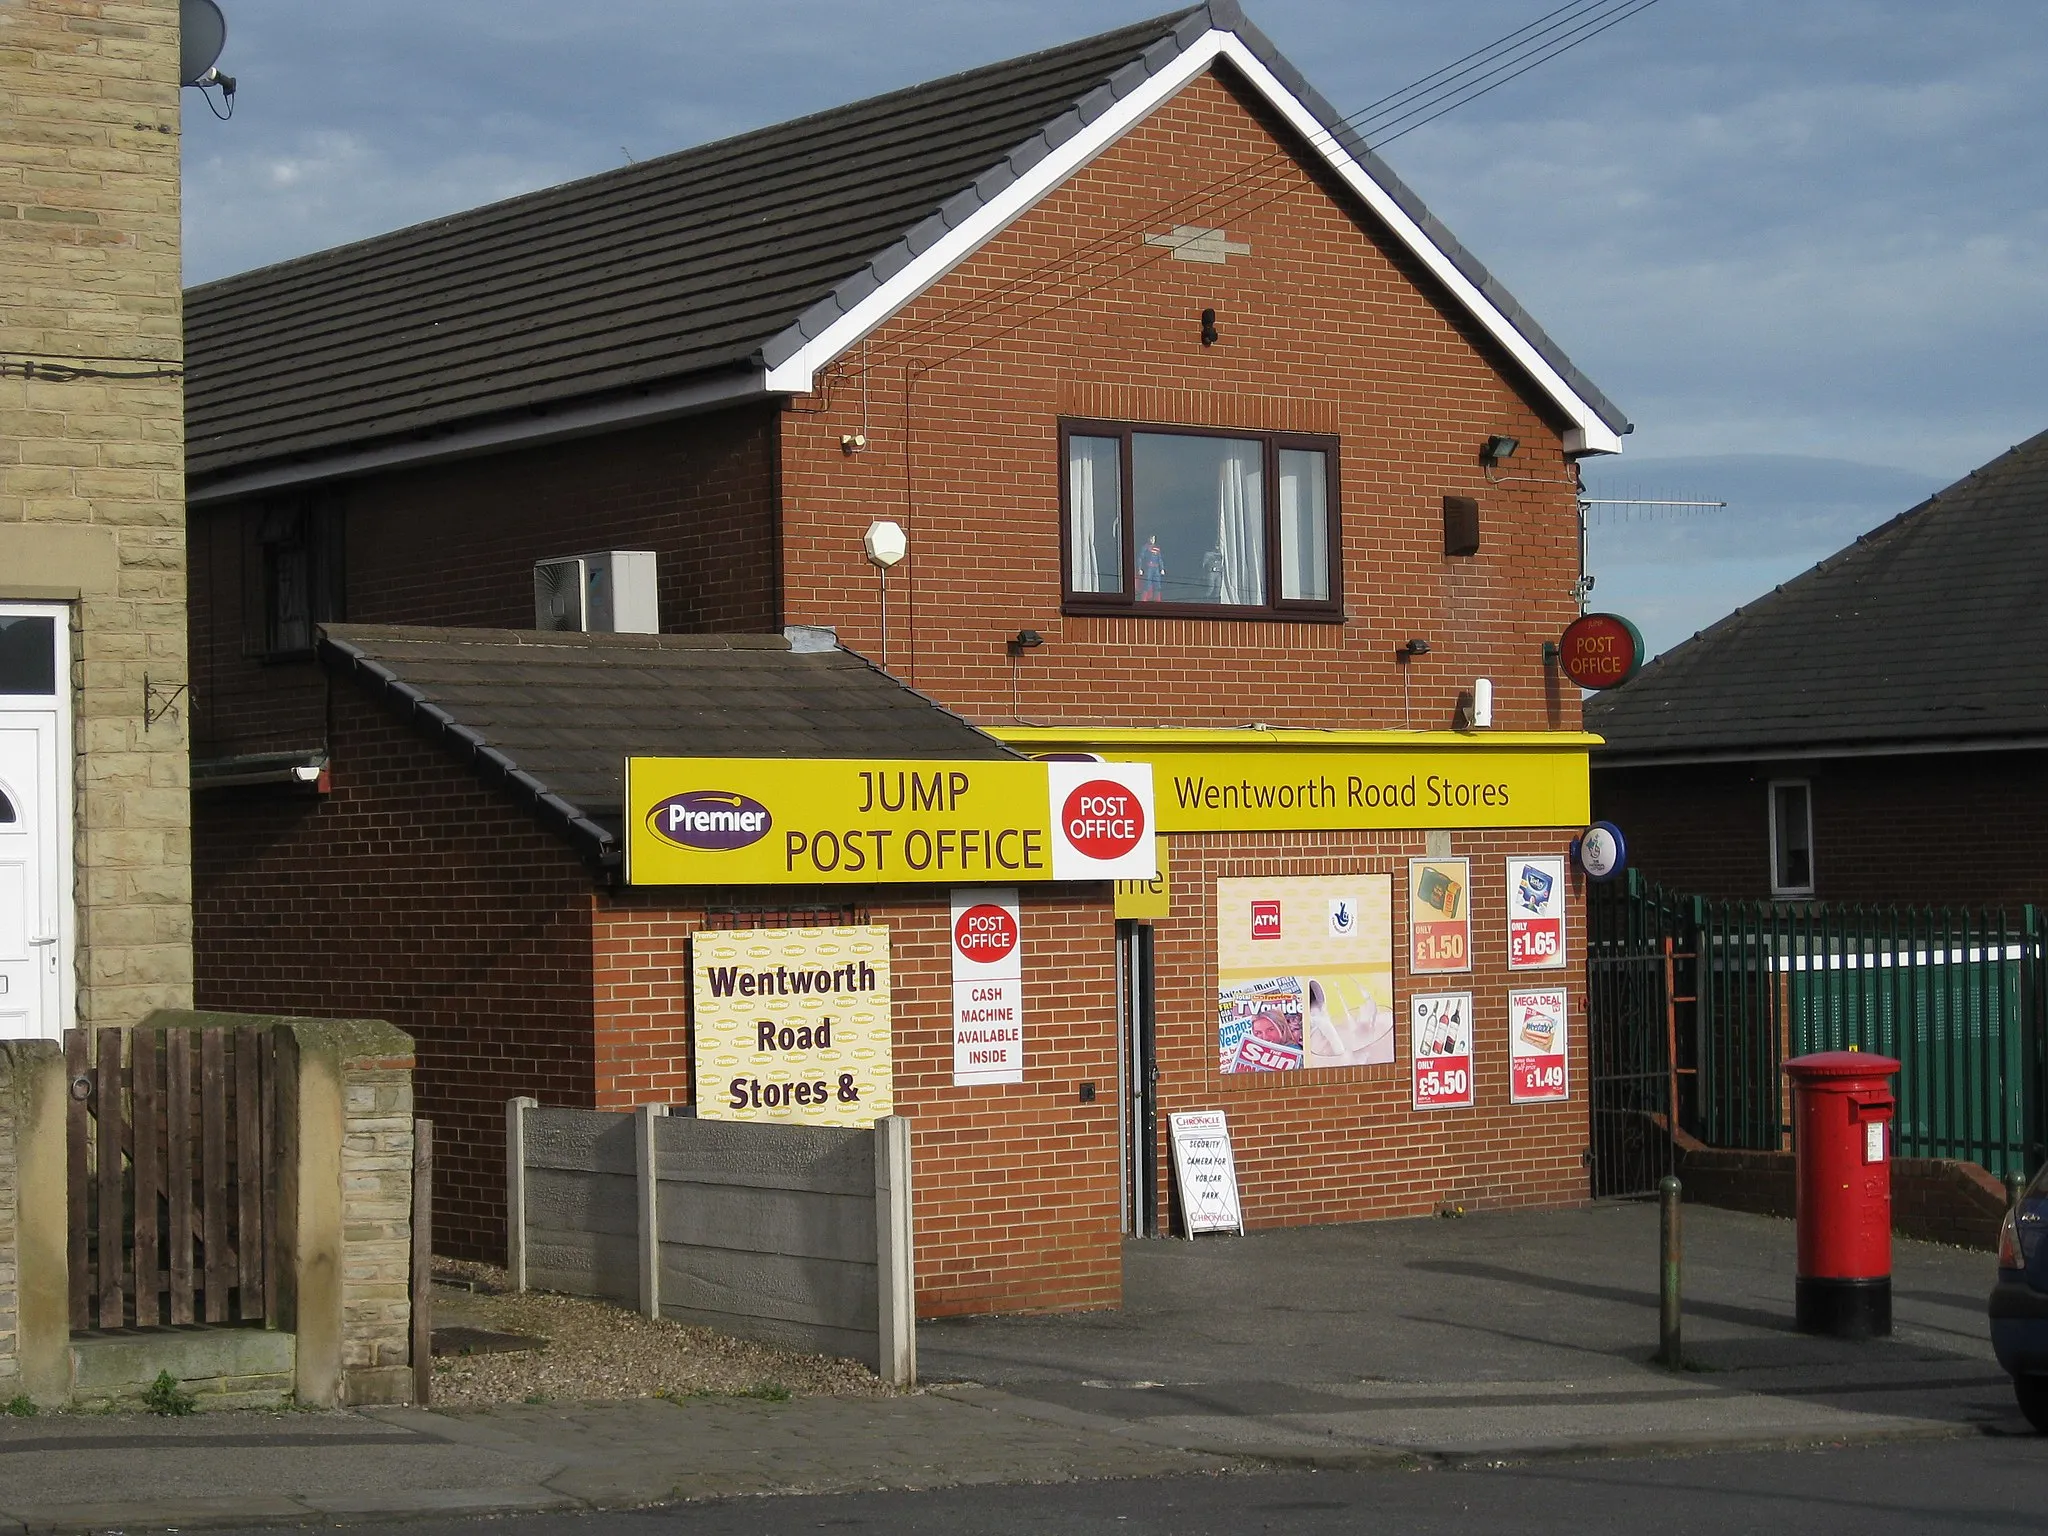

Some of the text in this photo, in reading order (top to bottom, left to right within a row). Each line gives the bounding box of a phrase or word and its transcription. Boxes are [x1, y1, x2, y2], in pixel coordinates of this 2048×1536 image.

[1576, 636, 1615, 654] POST
[1570, 657, 1621, 674] OFFICE
[858, 771, 970, 813] JUMP
[1174, 775, 1510, 810] Wentworth Road Stores
[1080, 796, 1128, 817] POST
[668, 803, 766, 833] Premier
[1069, 818, 1136, 840] OFFICE
[786, 829, 1044, 872] POST OFFICE
[968, 916, 1005, 932] POST
[1254, 914, 1279, 926] ATM
[1512, 922, 1528, 931] ONLY
[1415, 926, 1432, 935] ONLY
[960, 932, 1011, 949] OFFICE
[1417, 934, 1463, 960] £1.50
[1513, 932, 1556, 956] £1.65
[707, 960, 876, 998] Wentworth
[1253, 981, 1276, 991] Mail
[971, 987, 1003, 1002] CASH
[1514, 995, 1562, 1007] MEGA DEAL
[961, 1007, 1014, 1023] MACHINE
[757, 1017, 832, 1052] Road
[957, 1028, 1019, 1044] AVAILABLE
[969, 1049, 1007, 1065] INSIDE
[1242, 1043, 1296, 1070] Sun
[1417, 1060, 1434, 1070] ONLY
[1419, 1069, 1467, 1096] £5.50
[1526, 1066, 1563, 1088] £1.49
[729, 1073, 861, 1110] Stores &
[1176, 1116, 1220, 1126] CHRONICLE
[1189, 1140, 1220, 1148] SECURITY
[1209, 1175, 1222, 1183] CAR
[1202, 1191, 1220, 1200] PARK
